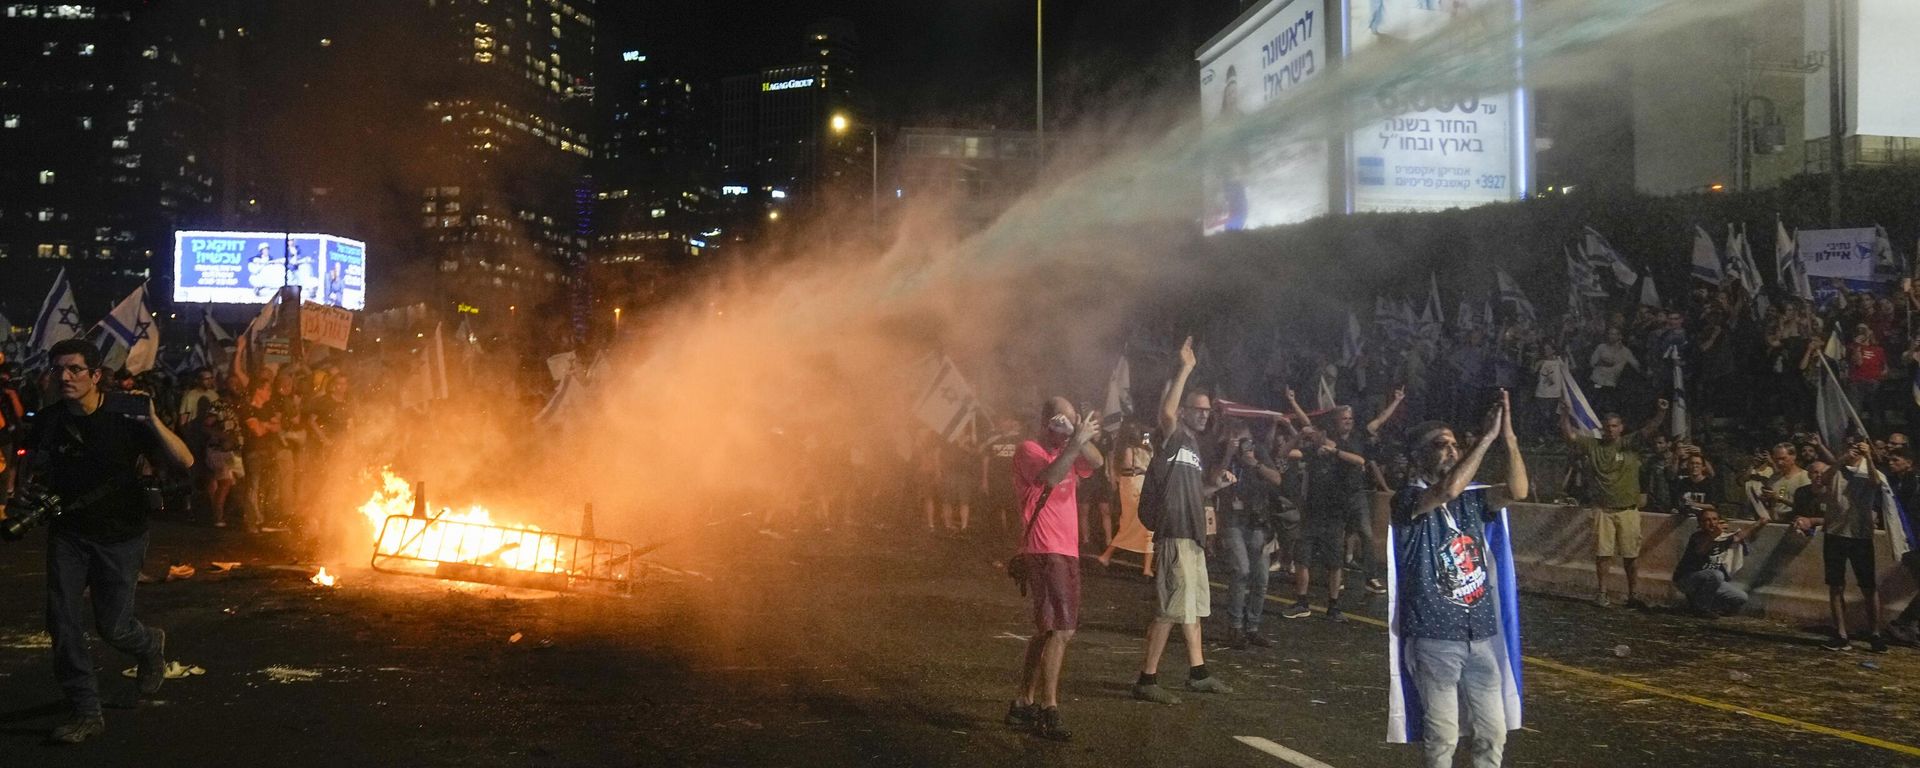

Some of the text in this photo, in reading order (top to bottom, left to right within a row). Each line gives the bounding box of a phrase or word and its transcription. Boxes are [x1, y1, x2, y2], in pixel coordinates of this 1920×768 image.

[1262, 10, 1314, 69] לראשונה
[1263, 49, 1315, 101] בישראל!
[1481, 103, 1497, 115] עד
[1385, 118, 1478, 134] החזר בשנה
[1439, 138, 1484, 156] בארץ
[1437, 166, 1471, 177] אמריקן
[1815, 249, 1851, 262] איילון
